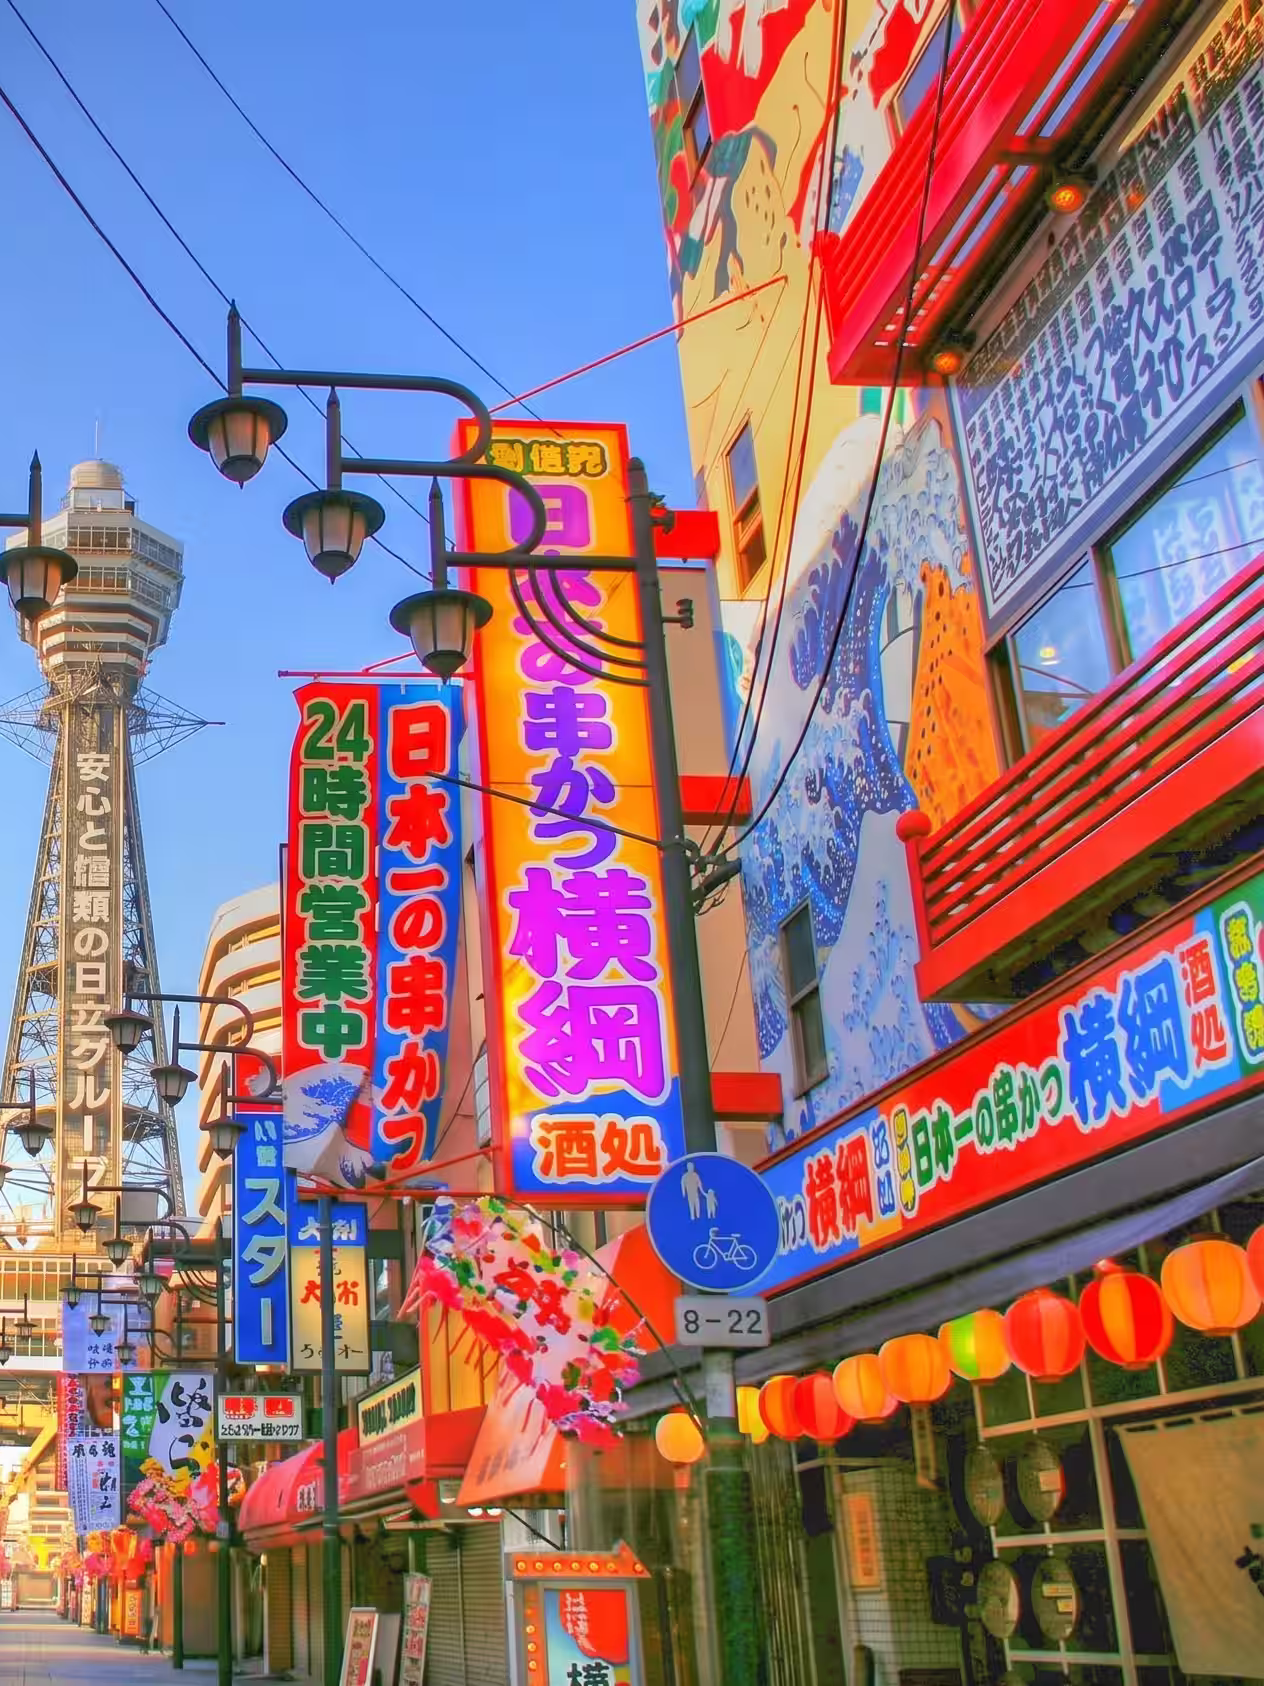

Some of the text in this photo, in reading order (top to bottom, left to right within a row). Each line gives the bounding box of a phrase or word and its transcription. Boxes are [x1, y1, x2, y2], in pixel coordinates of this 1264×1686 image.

[299, 700, 370, 1059] 24時間営業中
[382, 705, 450, 1171] 日本一の串かつ
[508, 868, 668, 1098] 横綱
[912, 1064, 1063, 1186] 日本一の串かつ
[1064, 957, 1191, 1124] 横綱
[1179, 938, 1227, 1068] 酒処
[538, 1116, 665, 1179] 酒処
[241, 1178, 287, 1345] スター
[684, 1309, 762, 1334] 8-22
